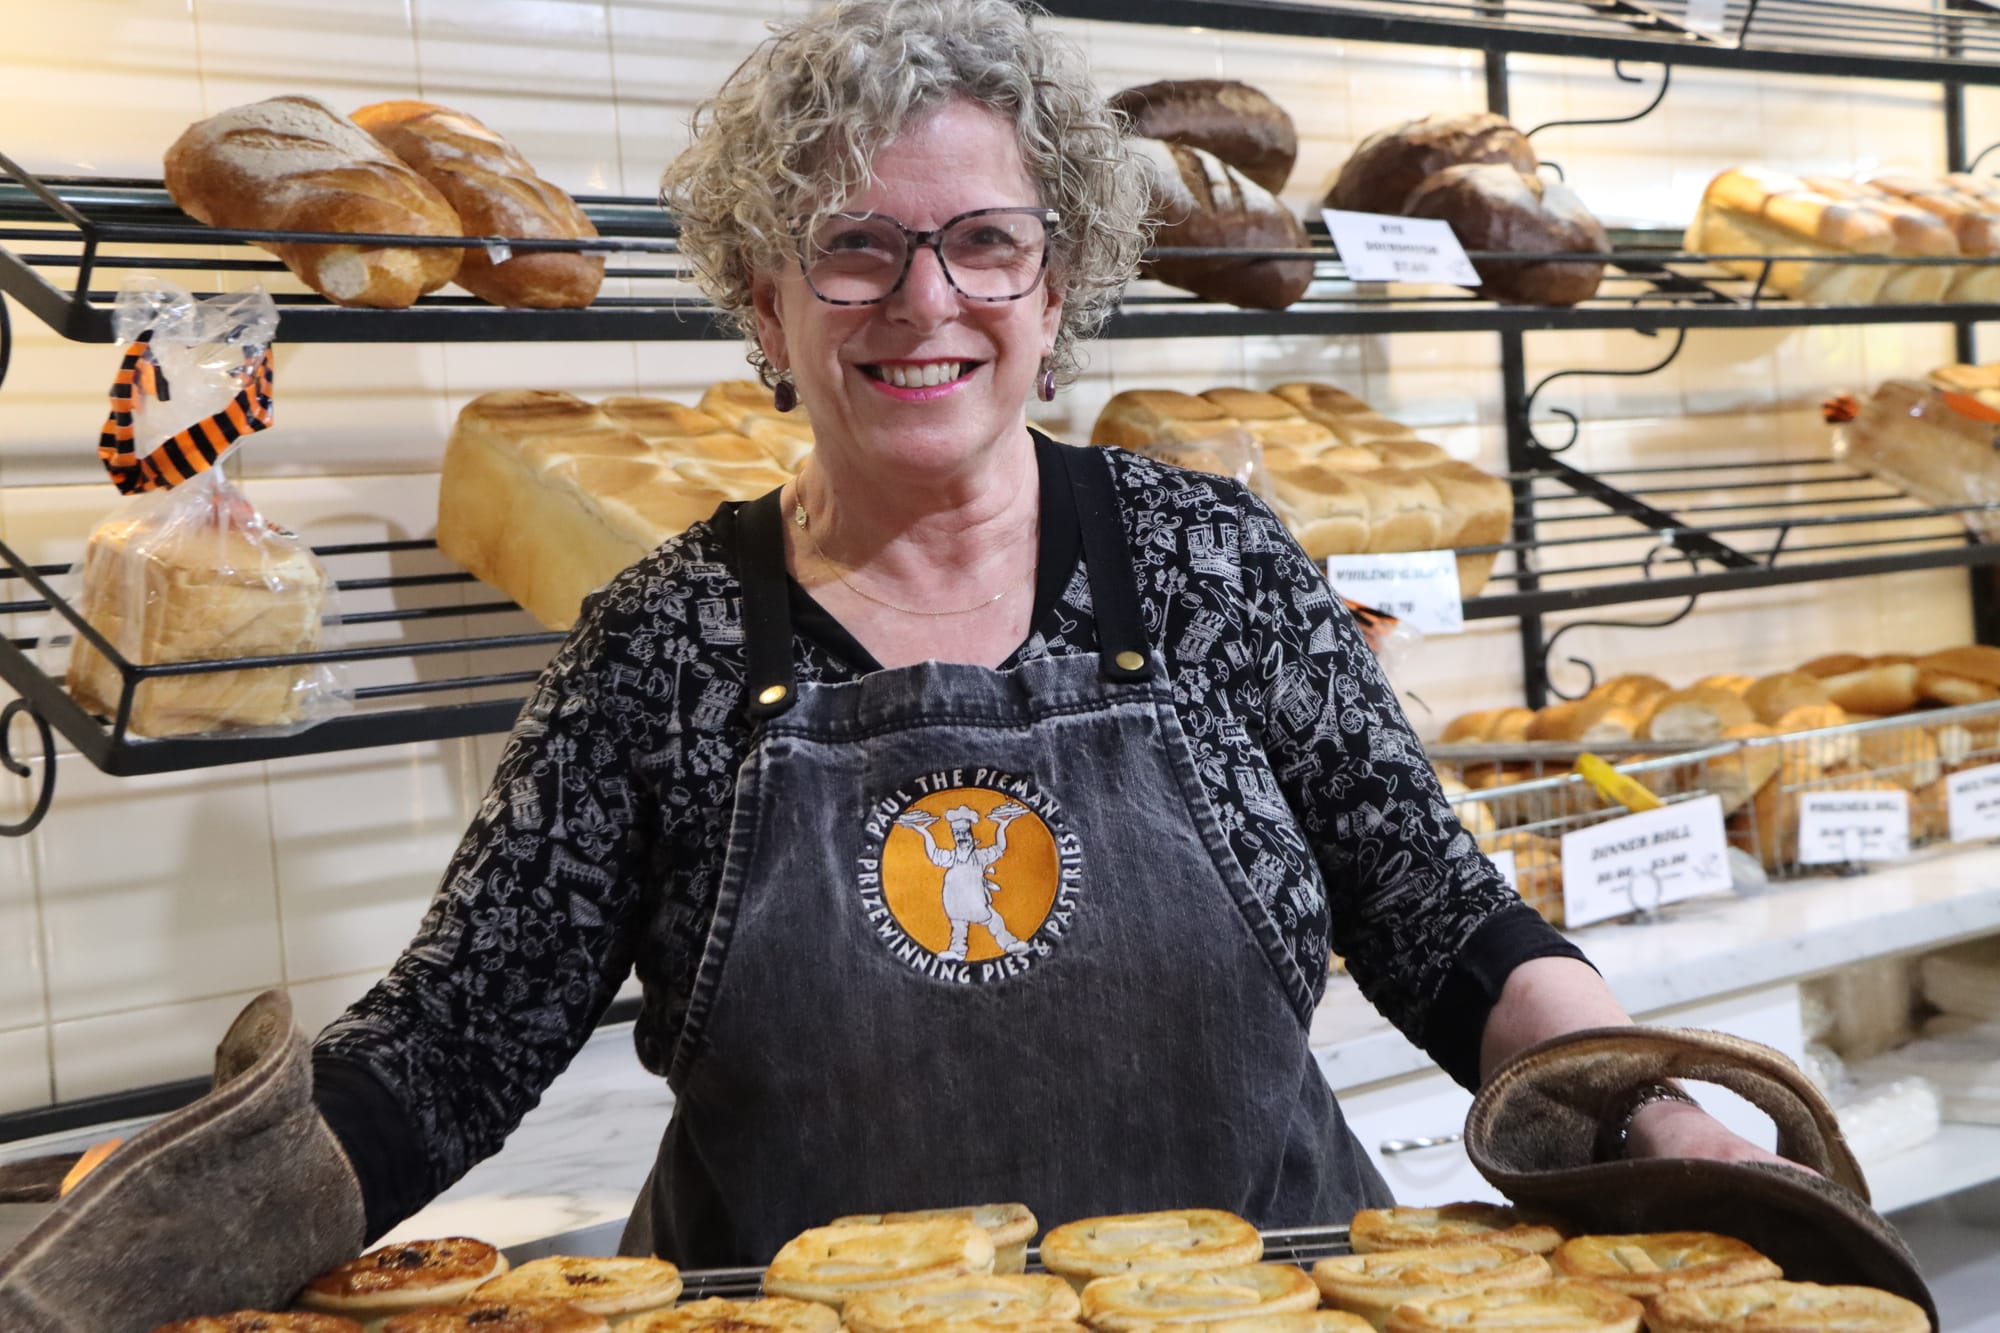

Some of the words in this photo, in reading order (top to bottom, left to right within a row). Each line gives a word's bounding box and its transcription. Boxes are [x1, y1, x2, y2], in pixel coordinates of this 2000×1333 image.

[866, 789, 912, 838] PAUL
[914, 769, 964, 793] THE
[975, 768, 1062, 820] PIEMAN
[857, 858, 970, 984] PRIZEWINNING
[983, 955, 1030, 982] PIES
[1033, 938, 1051, 956] &
[1045, 833, 1082, 937] PASTRIES
